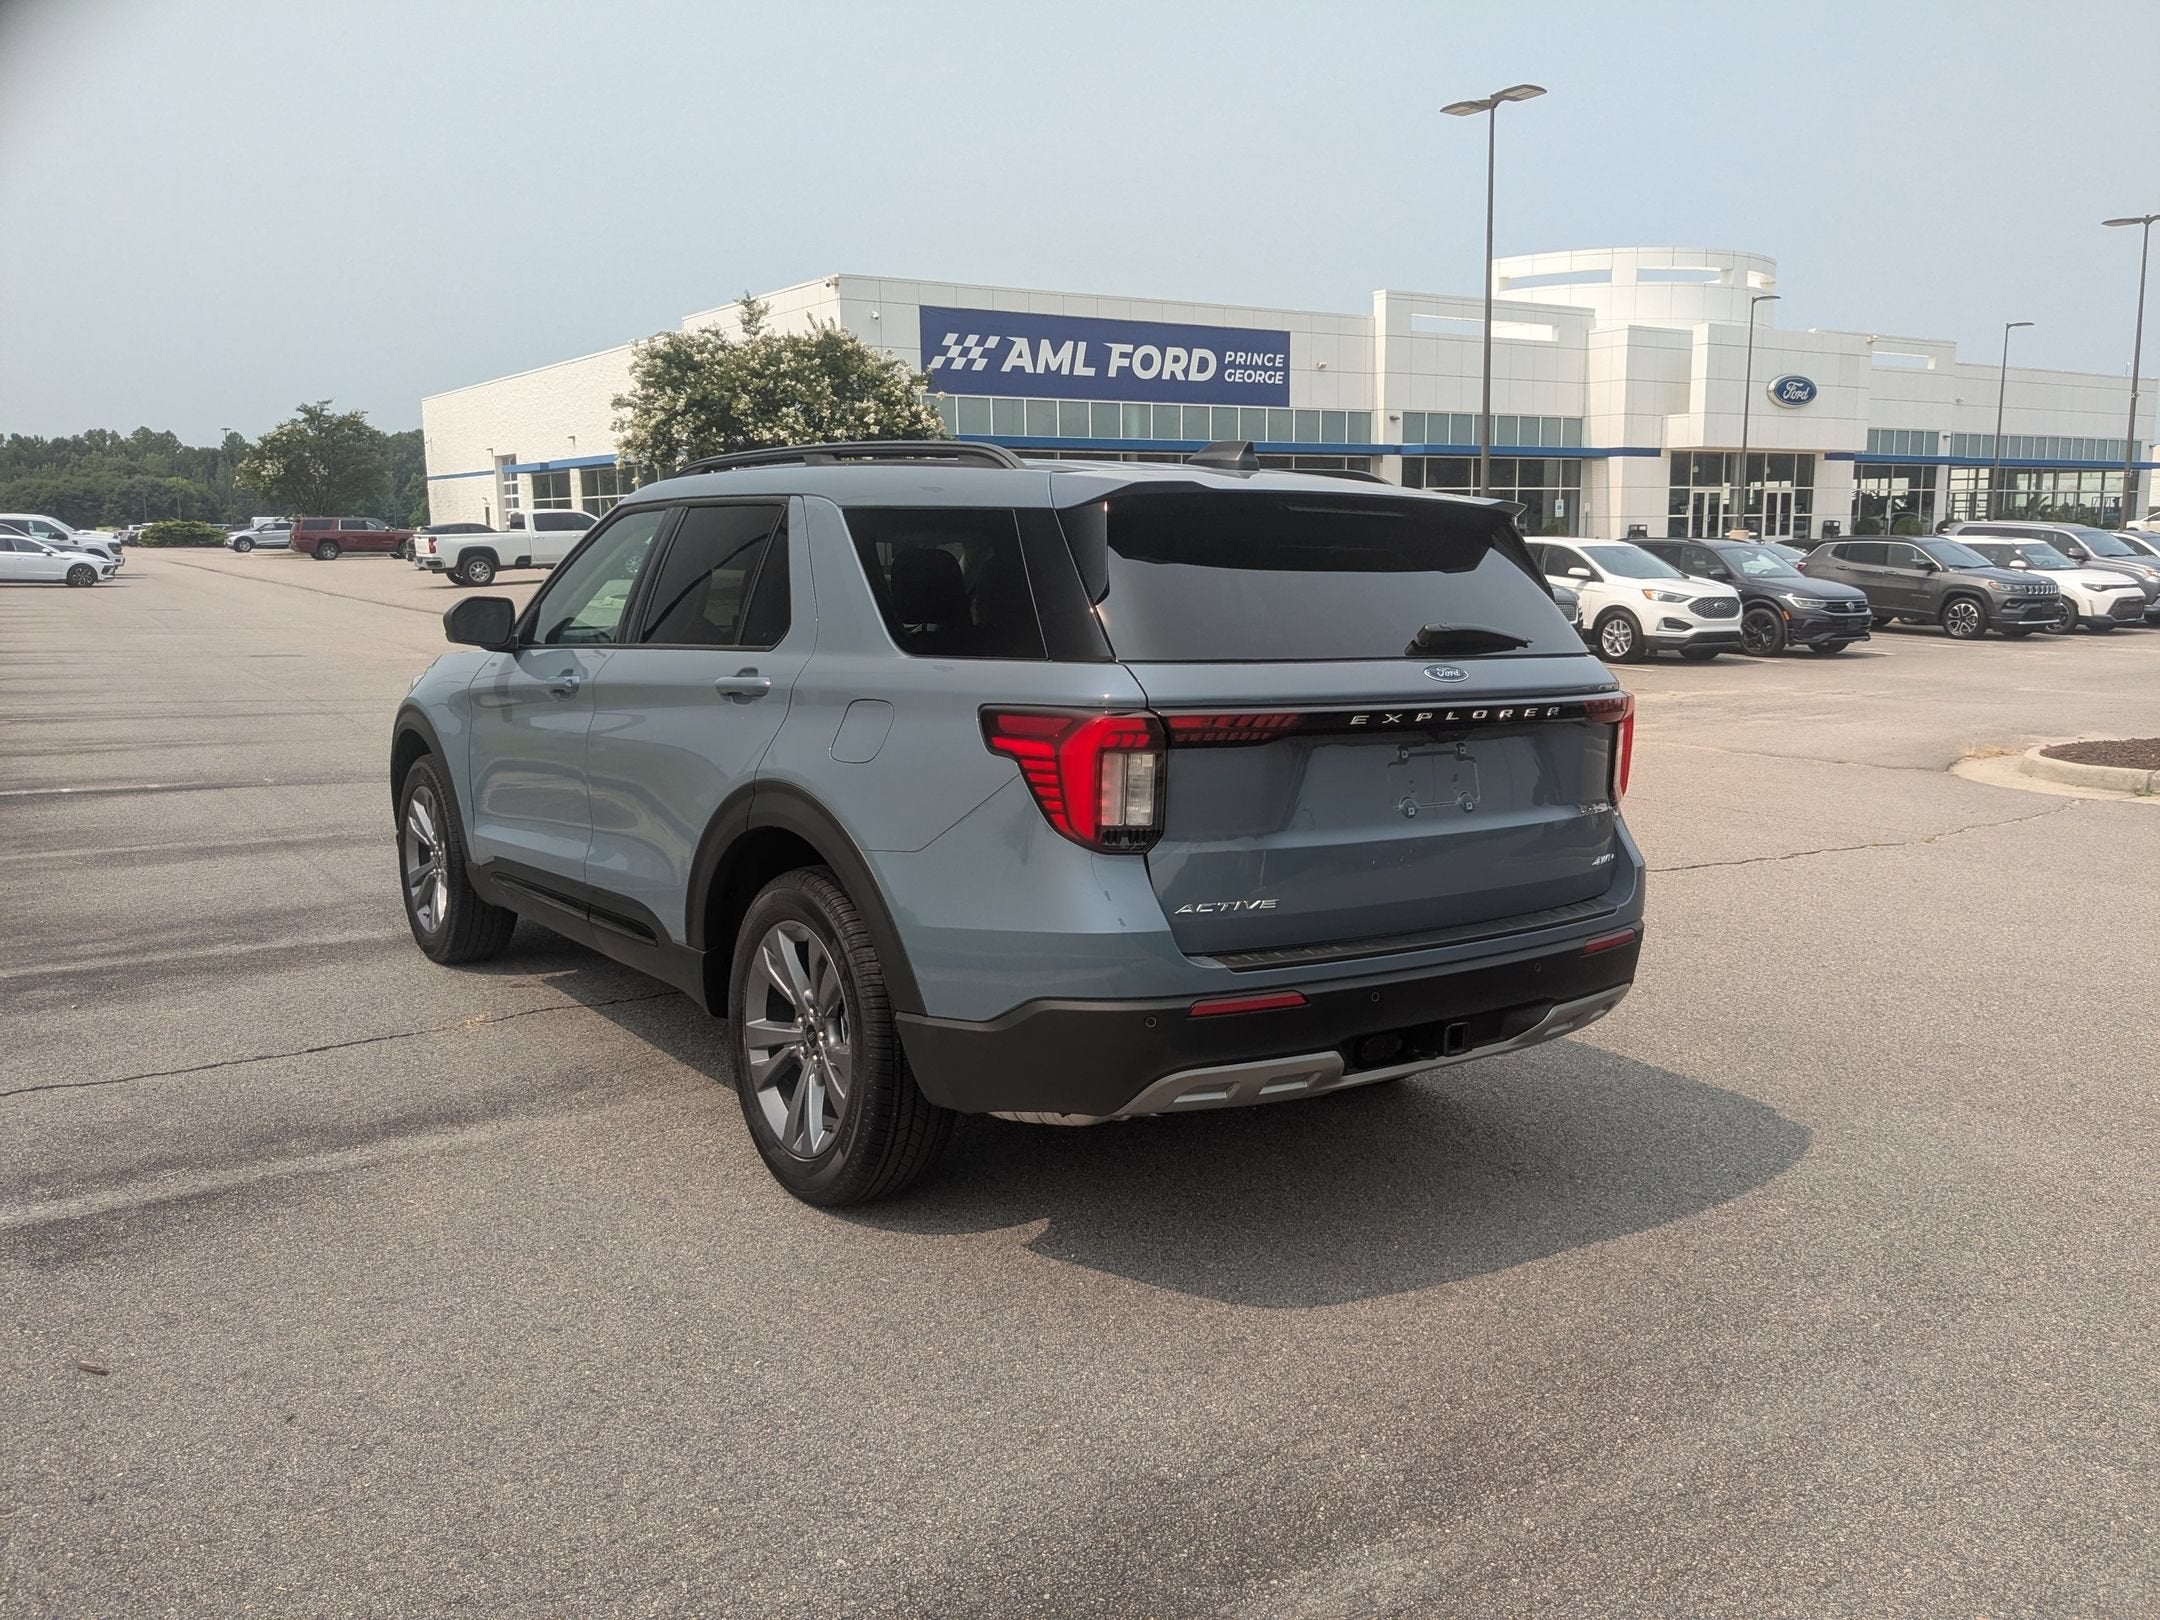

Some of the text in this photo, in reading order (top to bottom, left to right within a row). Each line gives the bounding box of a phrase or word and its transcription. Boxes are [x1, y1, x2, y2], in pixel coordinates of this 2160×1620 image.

[1000, 336, 1217, 382] AML FORD
[1224, 351, 1285, 367] PRINCE
[1224, 369, 1284, 385] GEORGE
[1782, 381, 1810, 400] Ford
[1436, 667, 1461, 677] Ford
[1350, 706, 1560, 725] EXPLORER
[1174, 899, 1280, 914] ACTIVE
